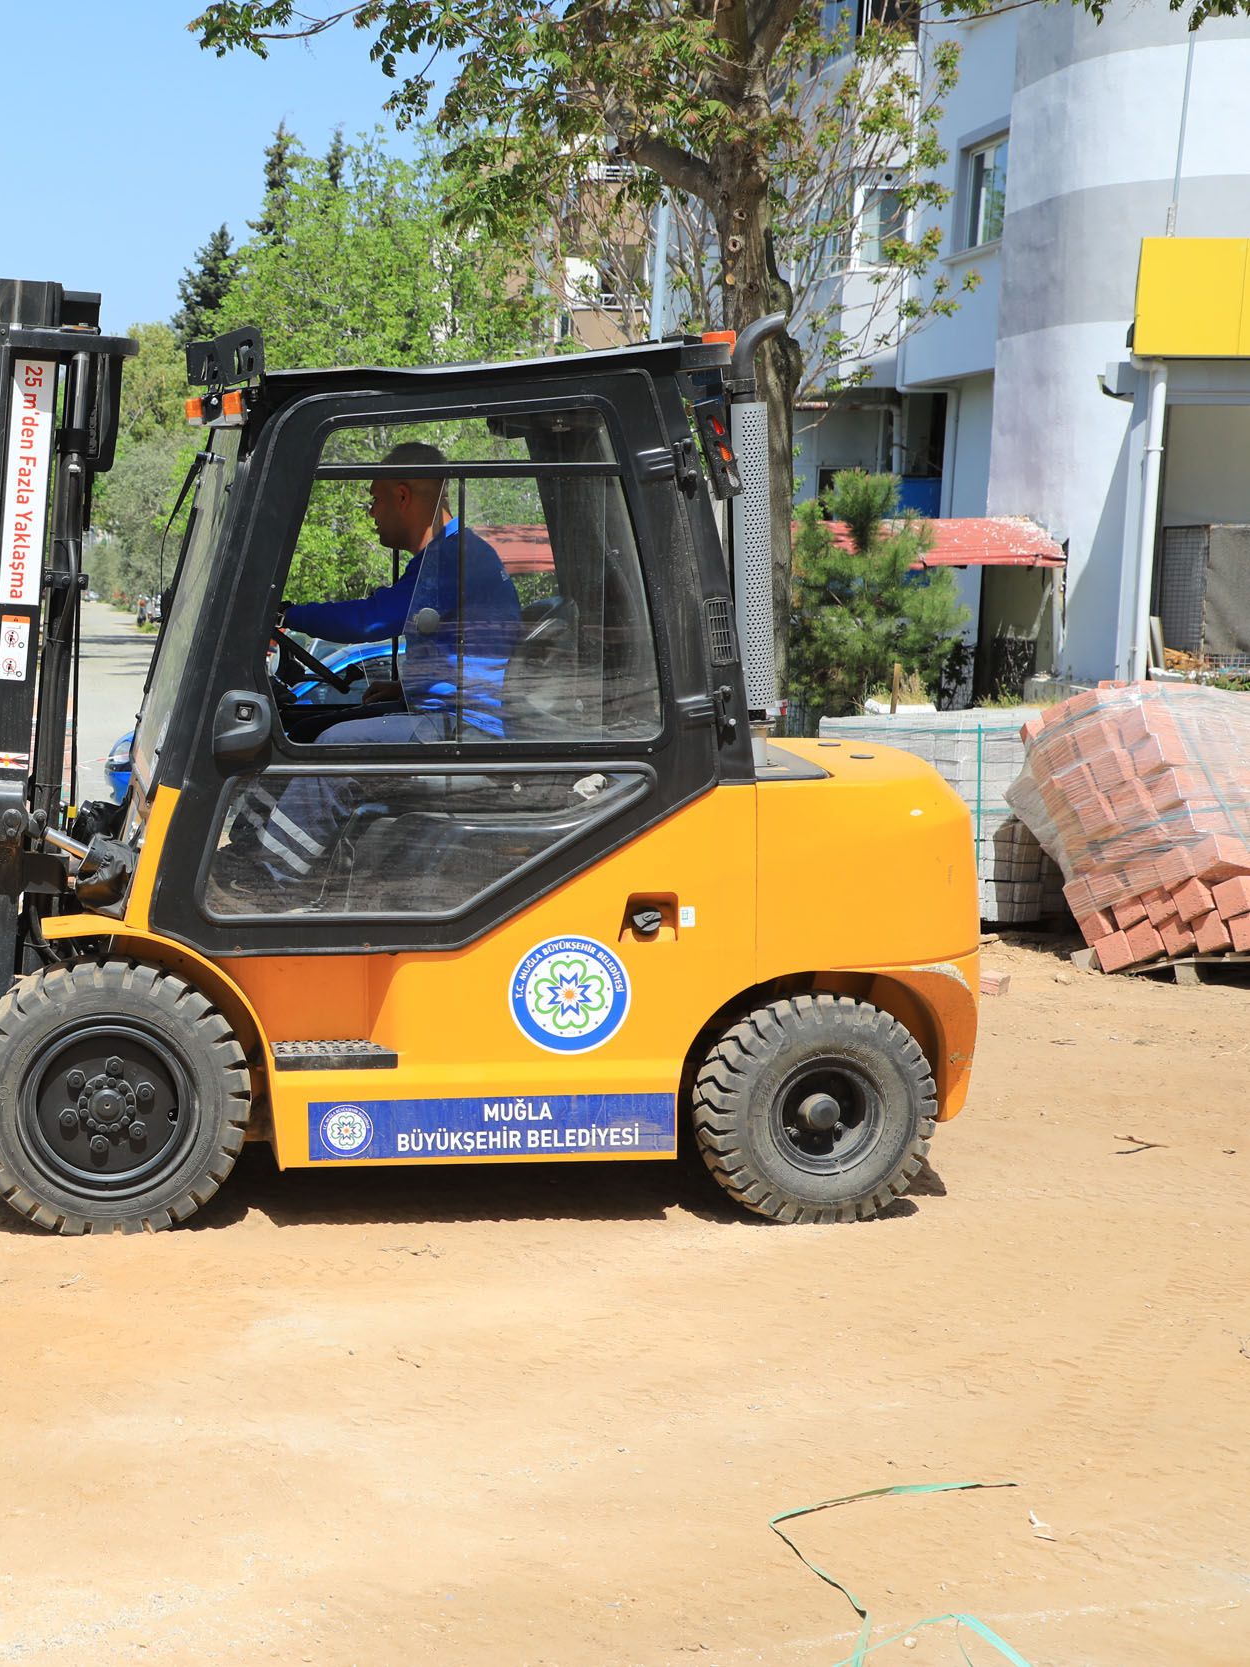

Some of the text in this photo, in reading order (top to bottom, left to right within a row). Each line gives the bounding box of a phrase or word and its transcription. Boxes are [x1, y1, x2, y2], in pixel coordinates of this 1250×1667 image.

[9, 365, 43, 600] 25 m'den Fazla Yaklaşma
[515, 941, 626, 999] T.C. MUĞLA BÜYÜKŞEHİR BELEDİYESİ
[483, 1098, 552, 1122] MUĞLA
[396, 1122, 639, 1153] BÜYÜKŞEHİR BELEDİYESİ
